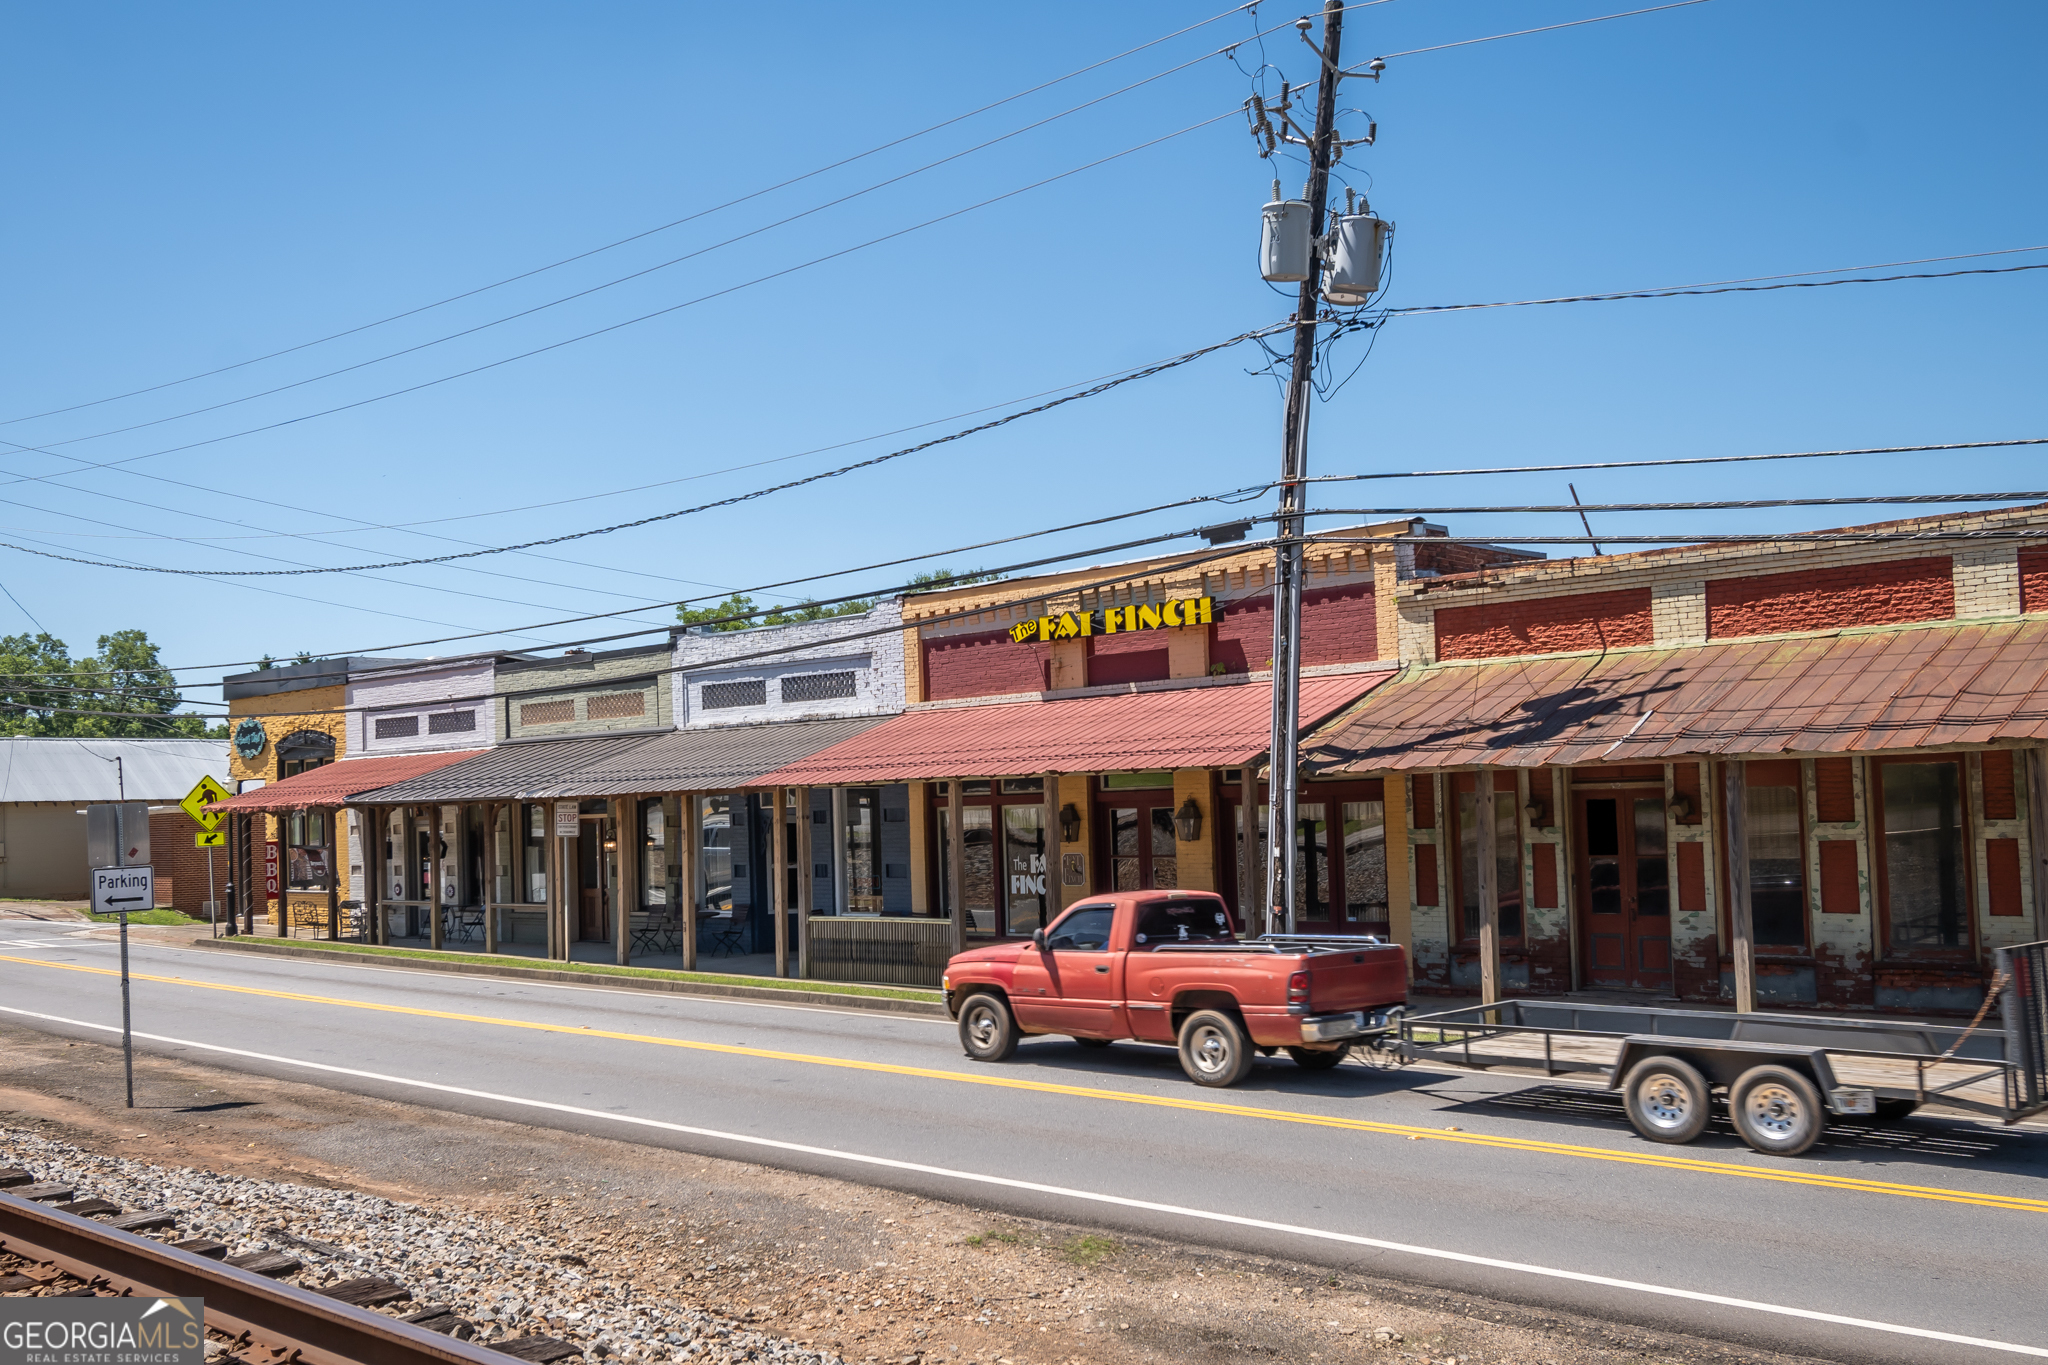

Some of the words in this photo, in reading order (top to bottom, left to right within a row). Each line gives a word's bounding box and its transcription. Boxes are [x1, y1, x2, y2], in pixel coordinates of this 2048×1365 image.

[1009, 619, 1038, 643] The
[1038, 611, 1094, 642] FAT
[1104, 596, 1213, 635] FINCH
[558, 813, 577, 822] STOP
[266, 844, 279, 893] BBQ
[1013, 855, 1028, 871] The
[1030, 853, 1047, 873] FA
[98, 873, 148, 891] Parking
[1011, 874, 1047, 895] FINC
